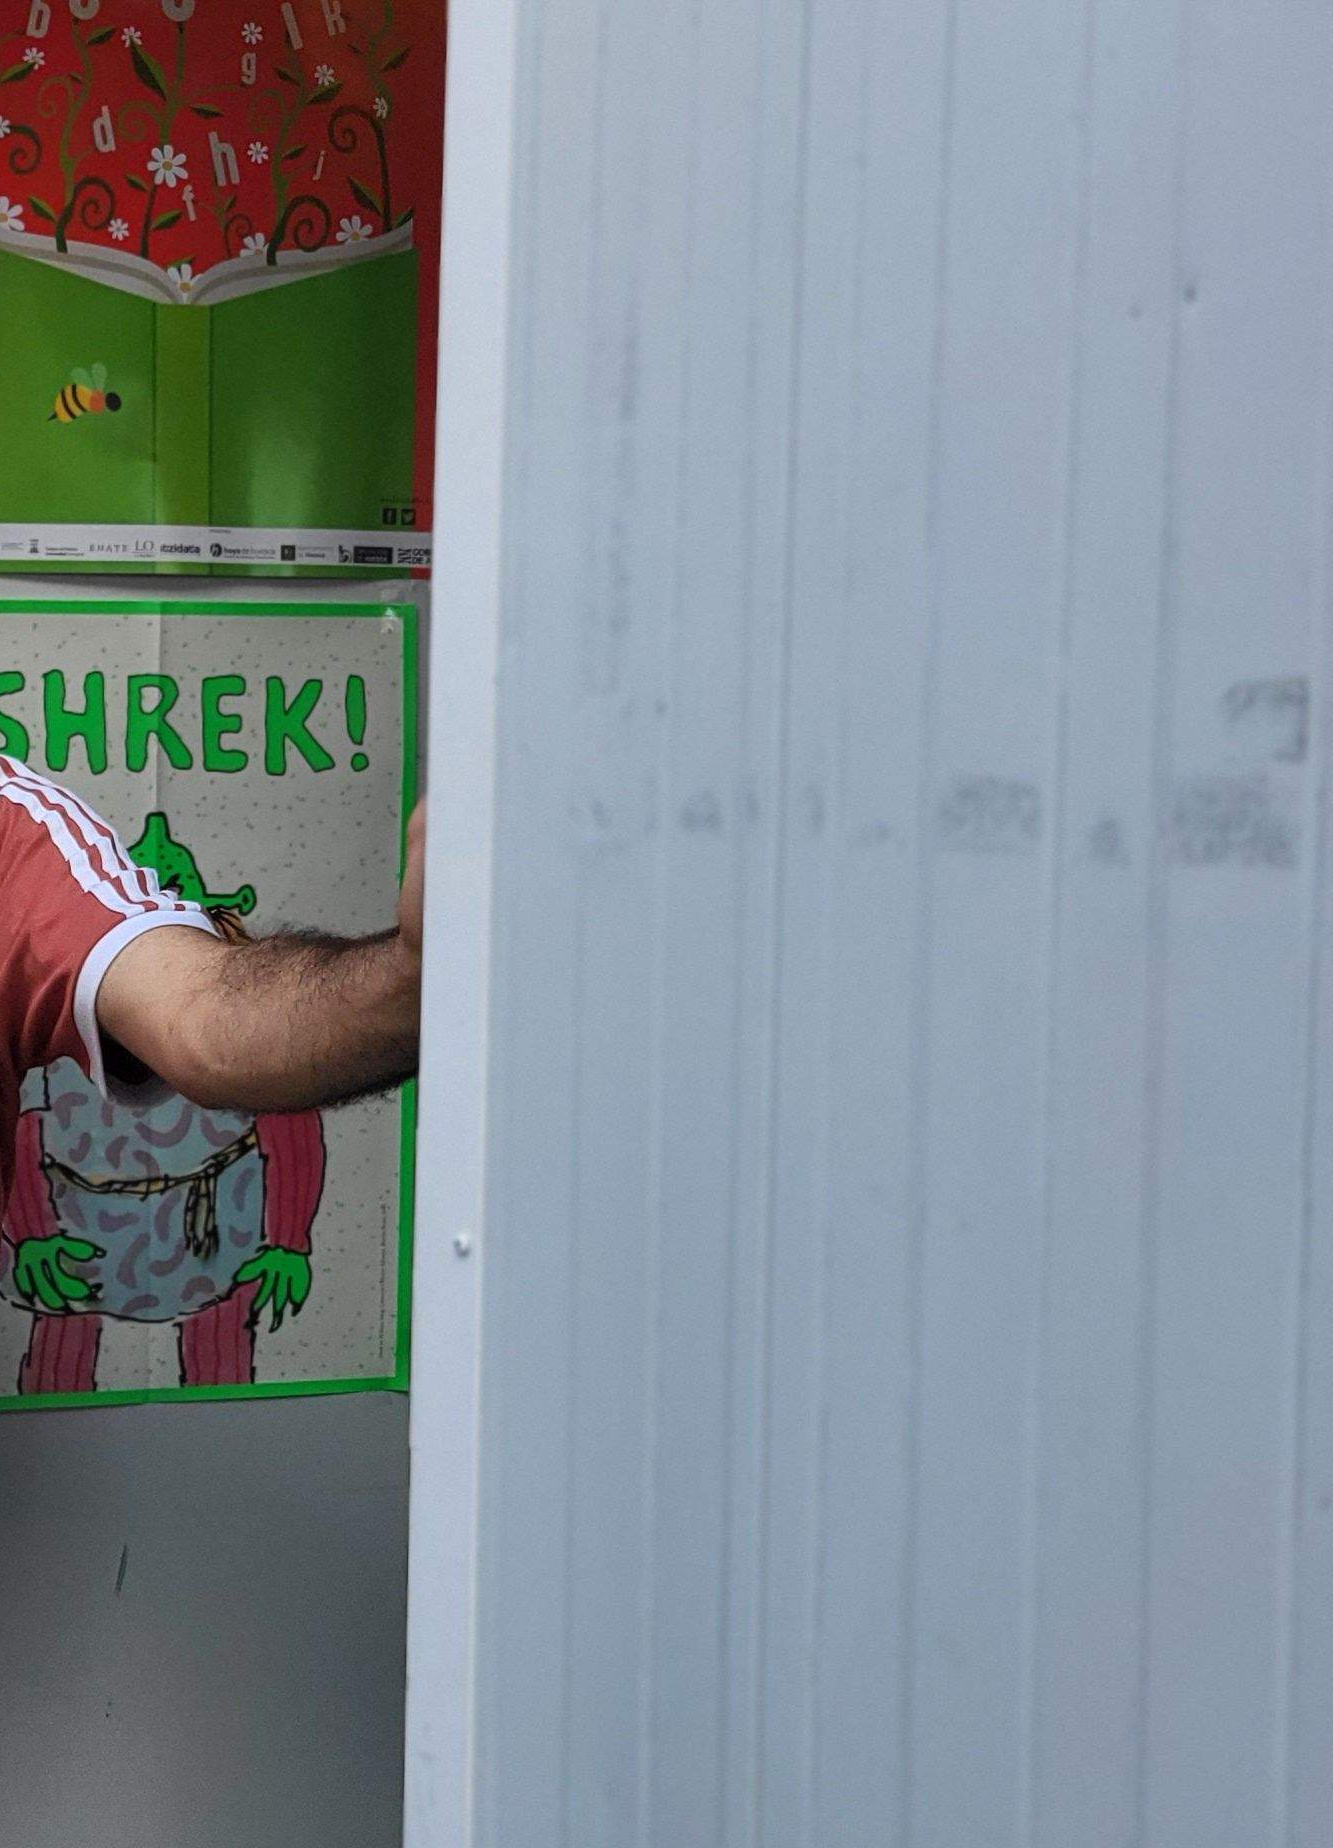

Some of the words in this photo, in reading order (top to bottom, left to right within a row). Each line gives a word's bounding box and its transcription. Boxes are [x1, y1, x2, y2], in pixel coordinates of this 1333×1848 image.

[241, 53, 257, 85] g
[93, 105, 116, 152] d
[208, 131, 240, 186] h
